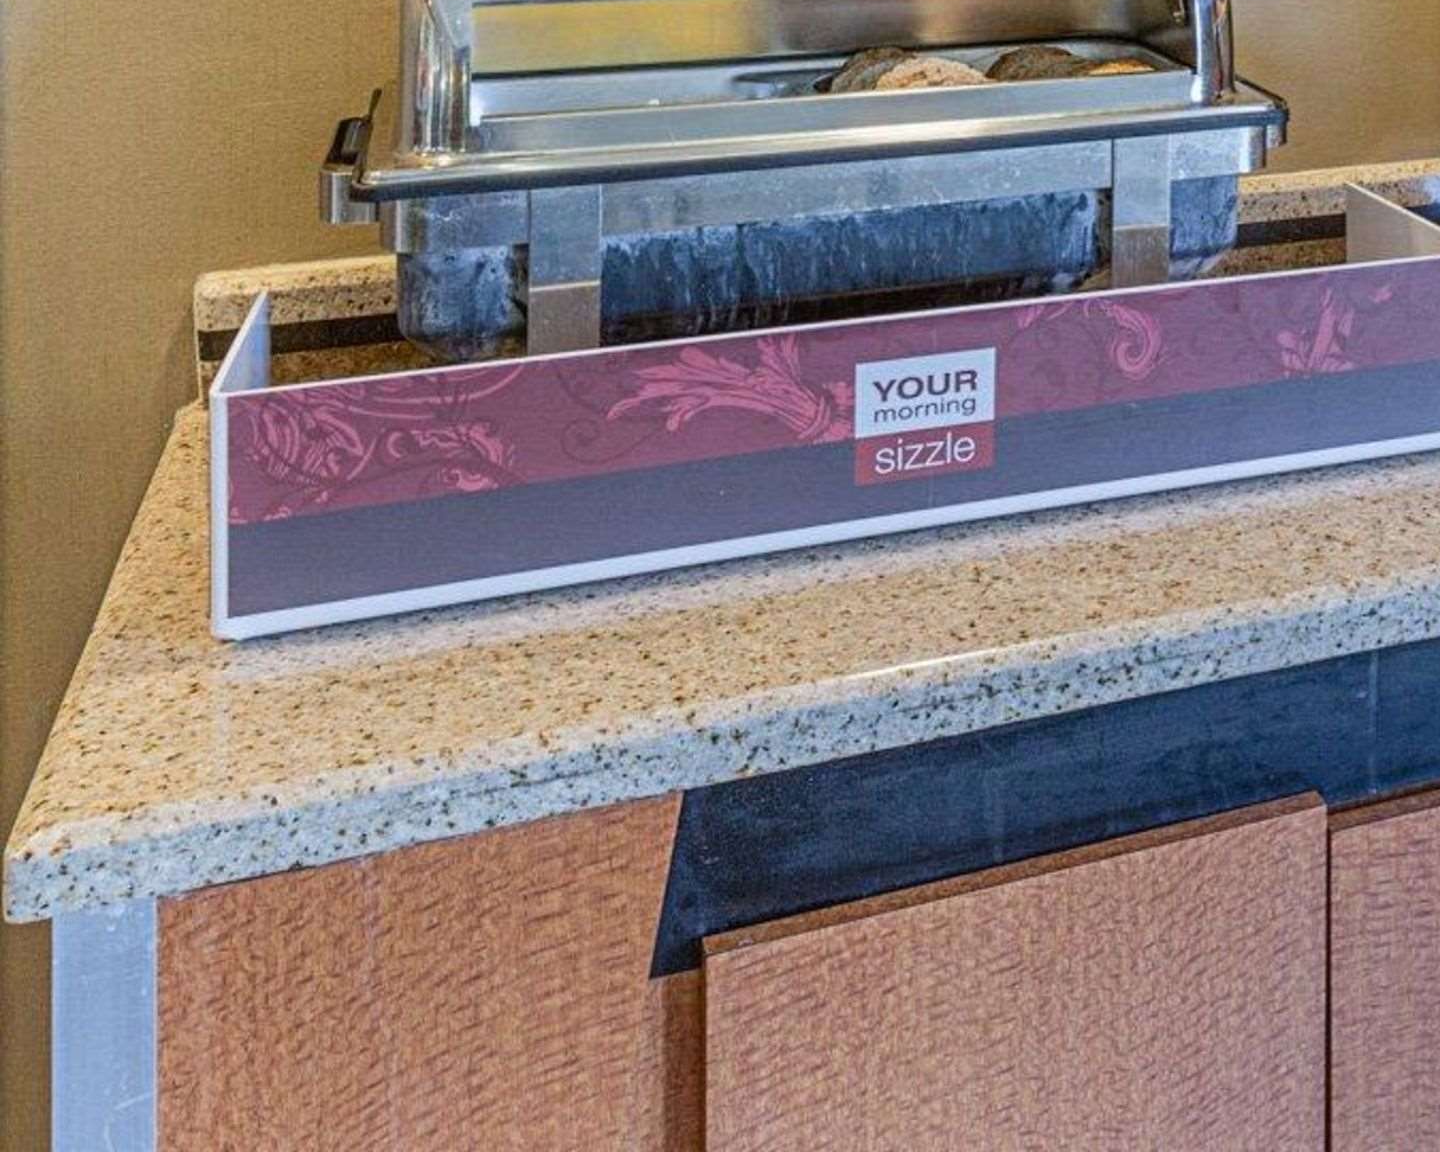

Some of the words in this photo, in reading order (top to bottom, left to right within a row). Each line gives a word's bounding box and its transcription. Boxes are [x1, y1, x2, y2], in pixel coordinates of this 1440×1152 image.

[872, 369, 978, 402] YOUR
[873, 397, 977, 423] morning
[875, 431, 976, 474] sizzle
